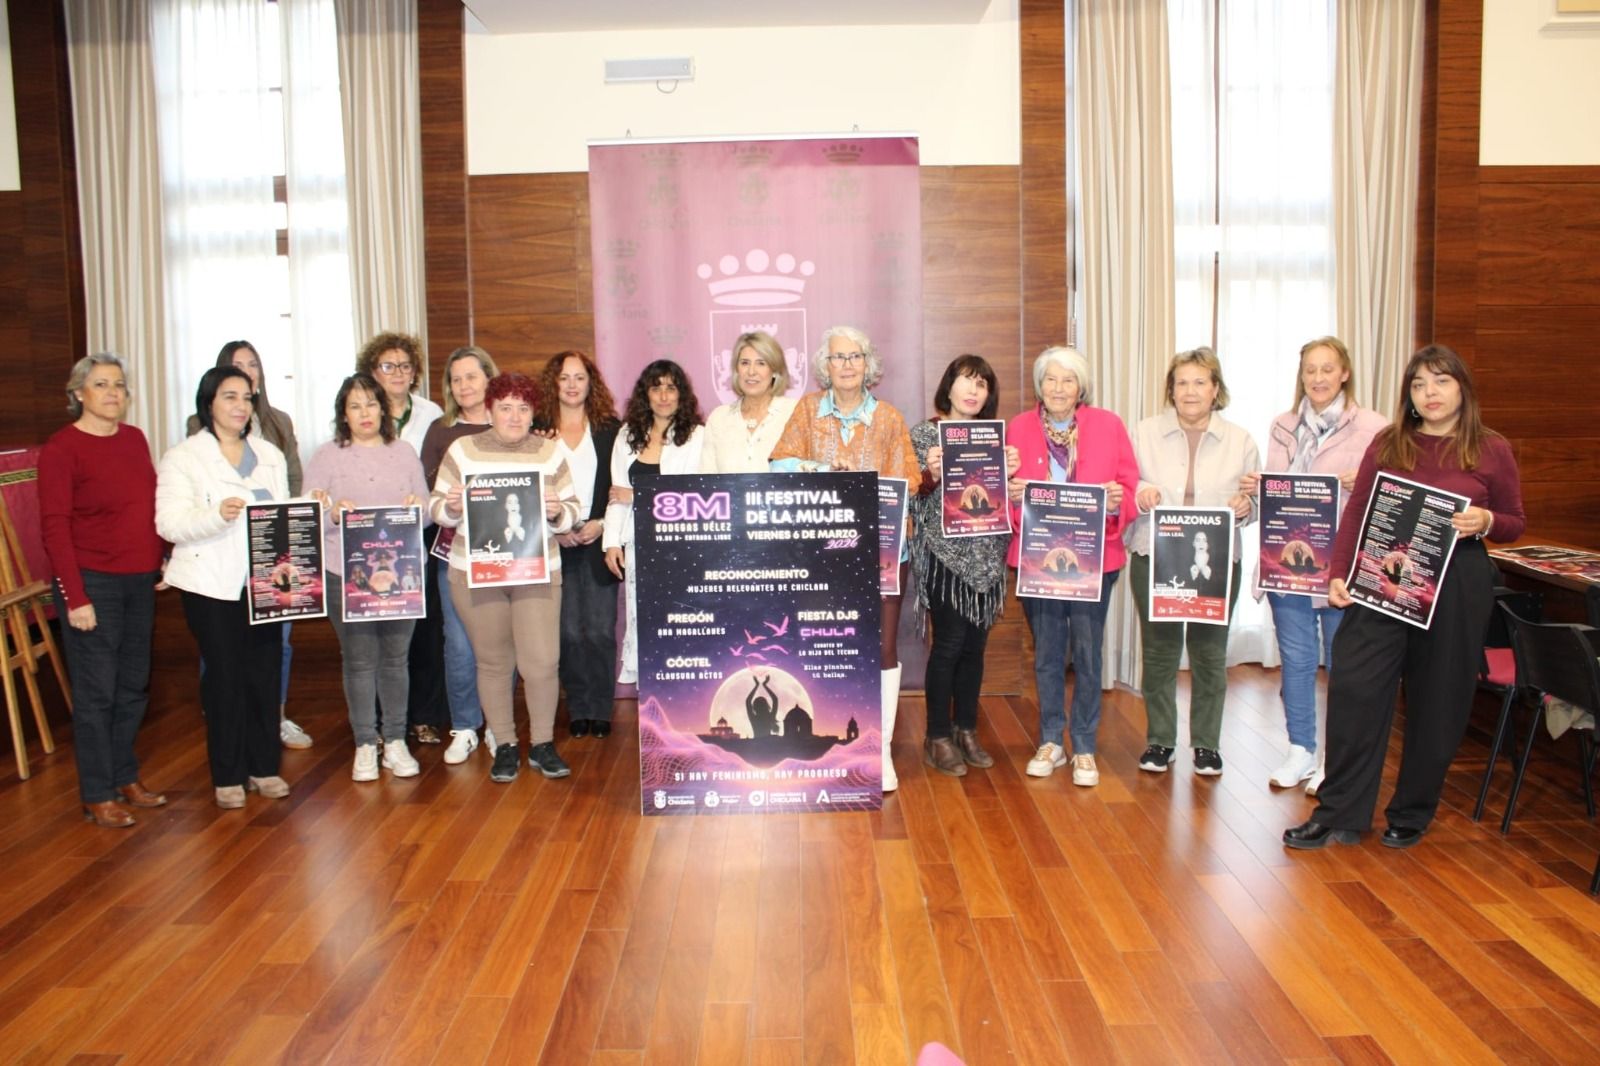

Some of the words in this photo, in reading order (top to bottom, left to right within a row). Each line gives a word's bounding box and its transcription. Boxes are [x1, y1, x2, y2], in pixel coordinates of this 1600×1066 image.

[470, 476, 531, 488] AMAZONAS
[764, 490, 842, 504] FESTIVAL
[653, 492, 731, 522] 8M
[746, 510, 768, 524] DE
[772, 510, 793, 524] LA
[796, 508, 856, 524] MUJER
[1159, 514, 1222, 526] AMAZONAS
[746, 530, 792, 540] VIERNES
[793, 530, 800, 540] 6
[802, 530, 816, 540] DE
[818, 529, 858, 539] MARZO
[704, 569, 810, 580] RECONOCIMIENTO
[667, 610, 714, 624] PREGÓN
[798, 611, 835, 621] FIESTA
[836, 610, 858, 620] DJS
[800, 627, 856, 637] CHULA
[666, 656, 712, 668] CÓCTEL
[675, 772, 684, 782] SI
[689, 772, 708, 781] HAY
[798, 768, 848, 778] PROGRESO
